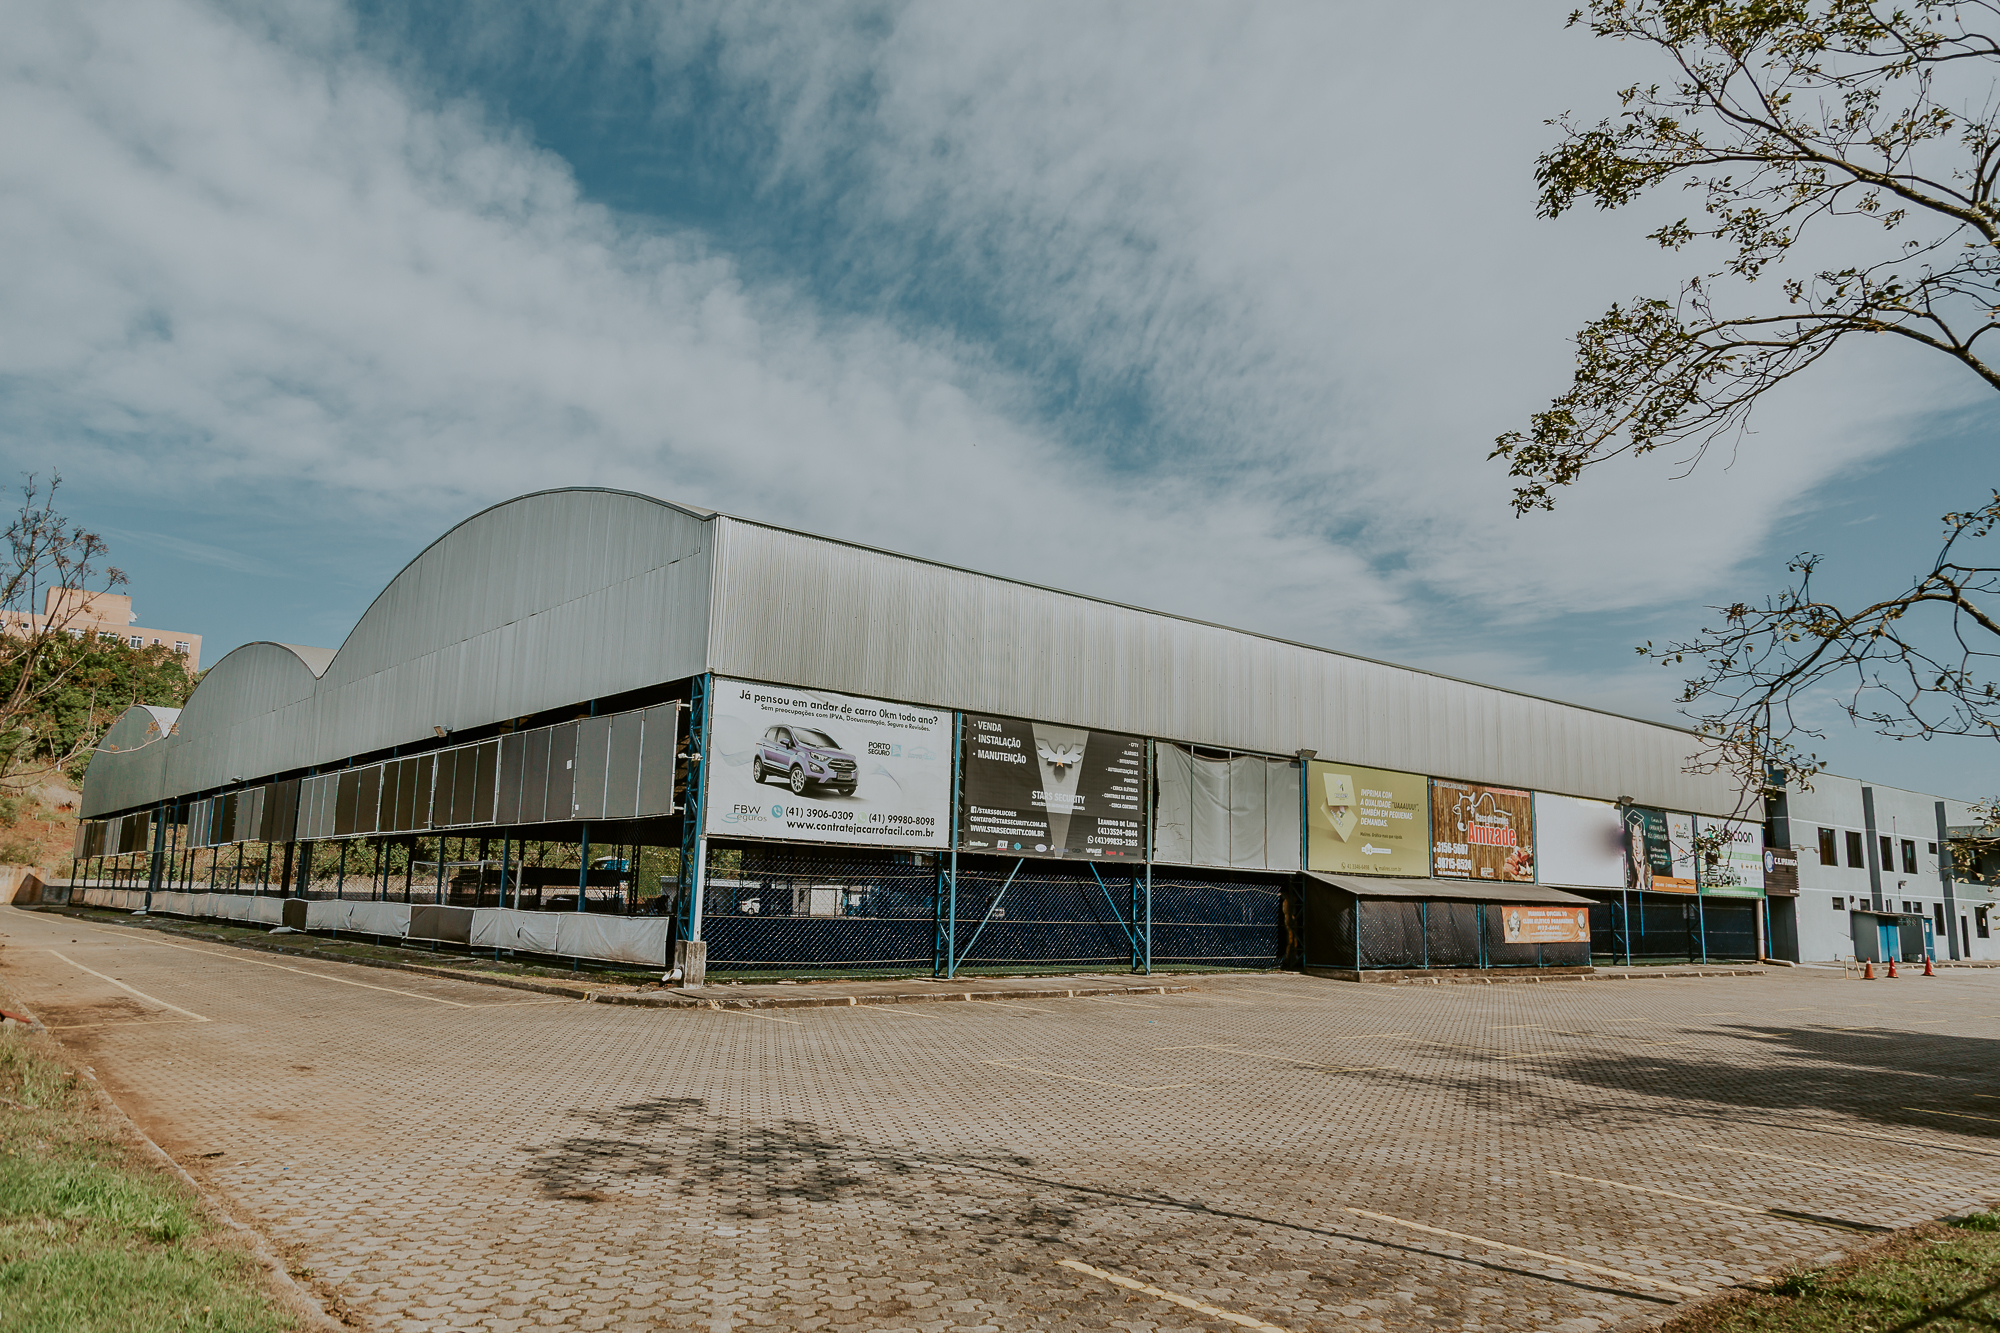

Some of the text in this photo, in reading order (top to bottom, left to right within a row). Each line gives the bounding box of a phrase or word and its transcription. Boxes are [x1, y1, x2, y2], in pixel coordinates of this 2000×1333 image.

[739, 689, 938, 725] Já pensou em andar de carro 0km todo ano?
[775, 707, 814, 717] preocupações
[829, 713, 845, 721] IPVA,
[978, 720, 1002, 732] VENDA
[868, 741, 890, 750] PORTO
[978, 733, 1021, 748] INSTALAÇÃO
[868, 748, 890, 756] SEGURO
[978, 749, 1027, 764] MANUTENÇÃO
[1031, 790, 1086, 804] STARS SECURITY
[1360, 788, 1393, 799] IMPRIMA COM
[733, 804, 761, 814] FBW
[1360, 798, 1364, 806] A
[1364, 798, 1391, 808] QUALIDADE
[721, 812, 767, 824] Seguros
[785, 806, 854, 820] (41) 3906-0309
[868, 813, 935, 826] (41) 99980-8098
[1360, 807, 1413, 820] TAMBÉM EM PEQUENAS
[1360, 817, 1389, 827] DEMANDAS.
[786, 820, 935, 838] www.contratejacarrofacil.com.br
[1467, 820, 1517, 848] Amizade
